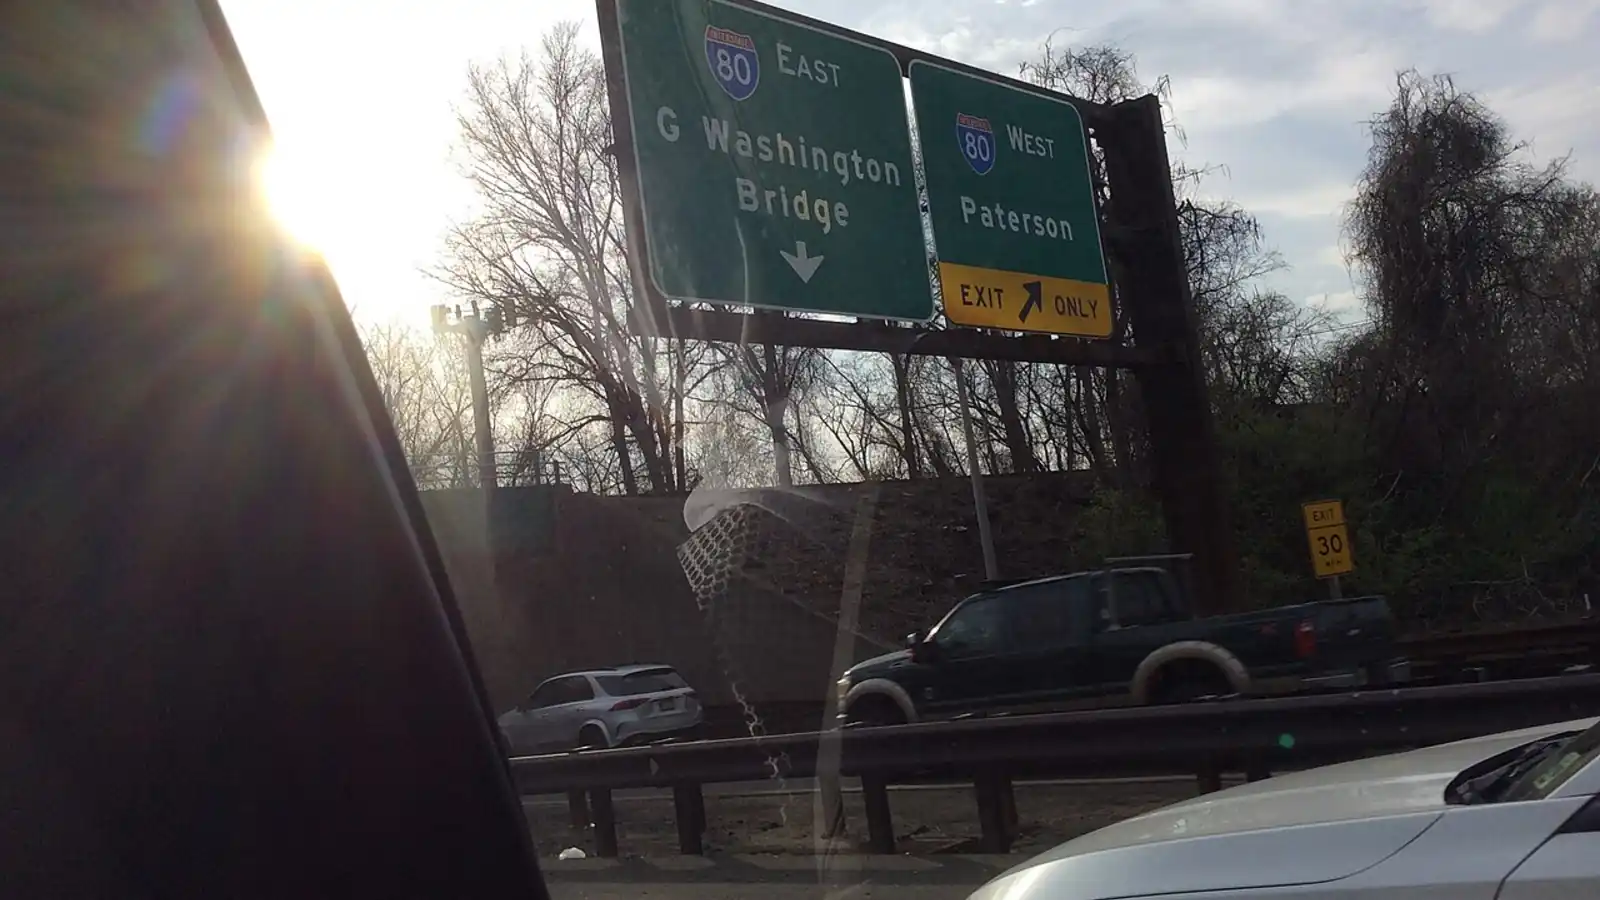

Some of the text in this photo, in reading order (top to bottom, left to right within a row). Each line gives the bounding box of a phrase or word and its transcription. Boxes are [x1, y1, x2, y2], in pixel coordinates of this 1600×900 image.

[717, 48, 752, 86] 80
[776, 41, 841, 87] EAST
[656, 105, 901, 187] G Washington
[965, 132, 990, 162] 80
[1006, 123, 1054, 159] WEST
[736, 177, 850, 235] Bridge
[960, 195, 1073, 241] Paterson
[960, 283, 1099, 320] EXIT ONLY
[1313, 508, 1334, 522] EXIT
[1317, 533, 1343, 556] 30
